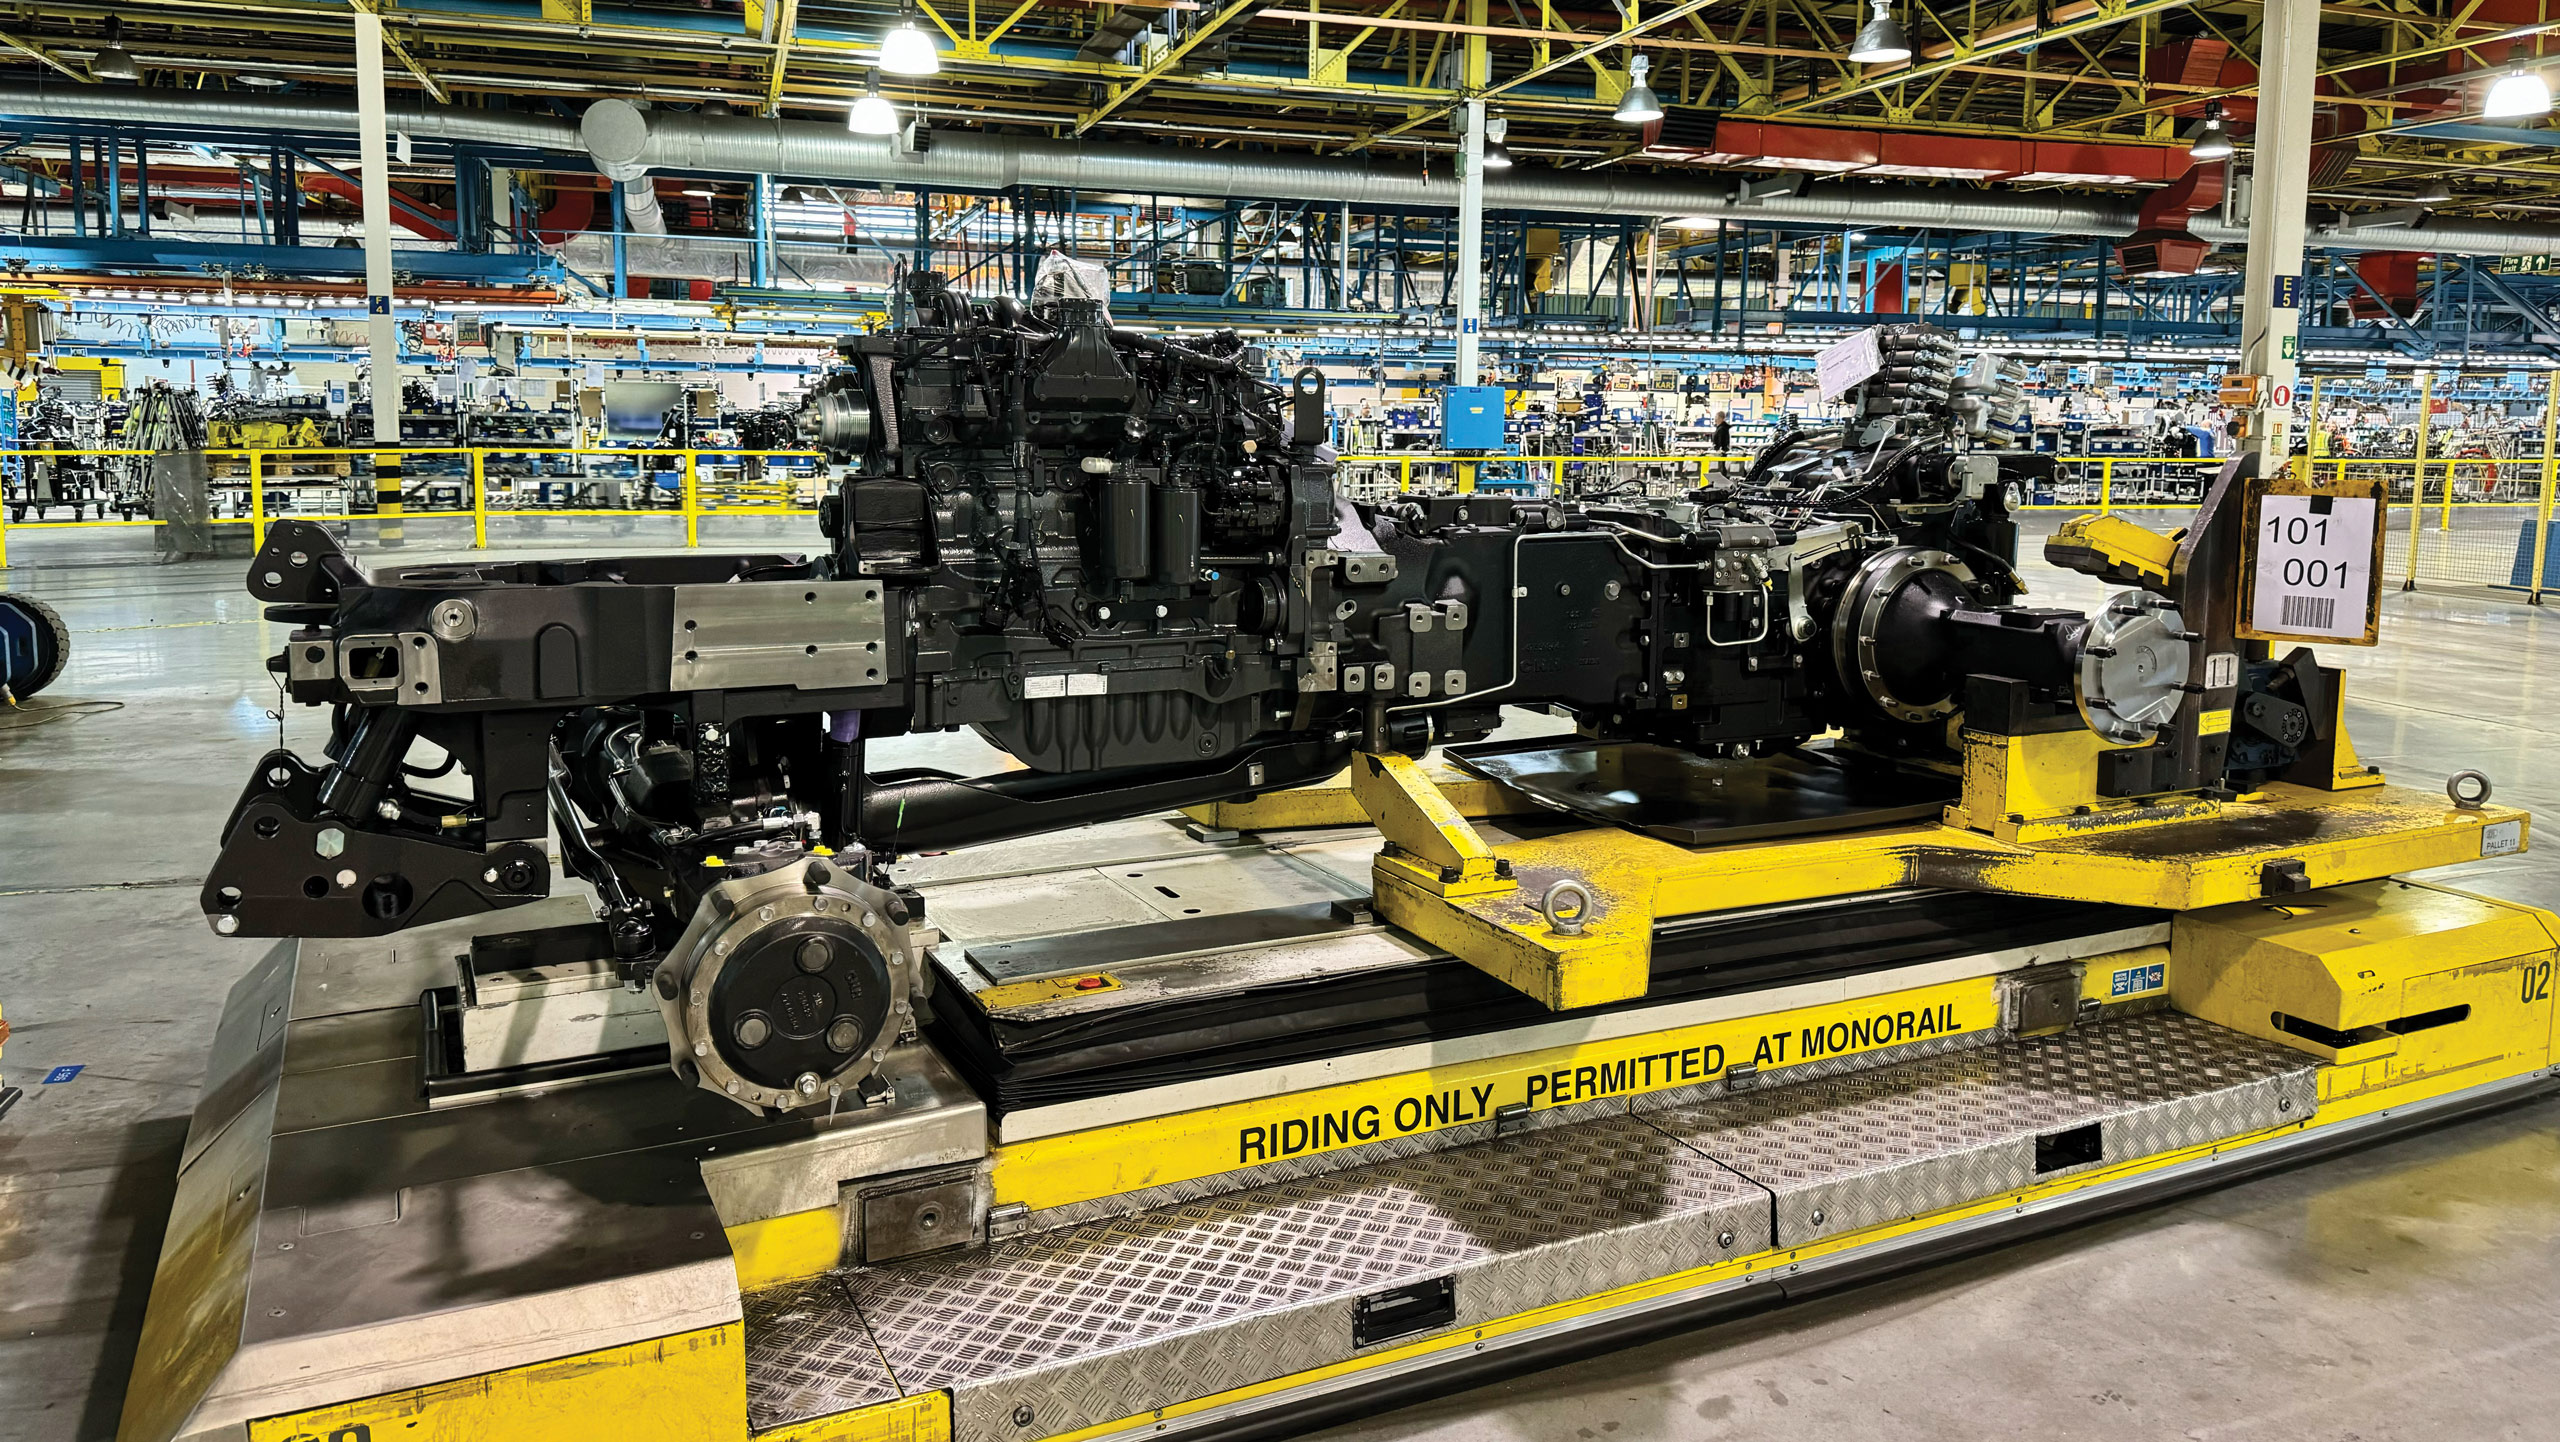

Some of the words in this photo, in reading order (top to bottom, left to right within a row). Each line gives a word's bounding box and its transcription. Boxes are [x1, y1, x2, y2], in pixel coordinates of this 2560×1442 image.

[2283, 277, 2293, 291] E
[375, 296, 382, 305] F
[2282, 293, 2291, 307] 5
[376, 305, 383, 314] 4
[1655, 381, 1675, 389] KARS
[702, 471, 709, 480] 3
[2267, 516, 2327, 546] 101
[2283, 558, 2347, 589] 001
[2211, 657, 2231, 687] 11
[2486, 839, 2508, 850] PALLET
[2521, 961, 2550, 1004] 02
[1239, 1105, 1380, 1163] RIDING
[1394, 1083, 1494, 1132] ONLY
[1527, 1044, 1725, 1107] PERMITTED
[1753, 1031, 1791, 1065] AT
[1801, 1003, 1961, 1058] MONORAIL
